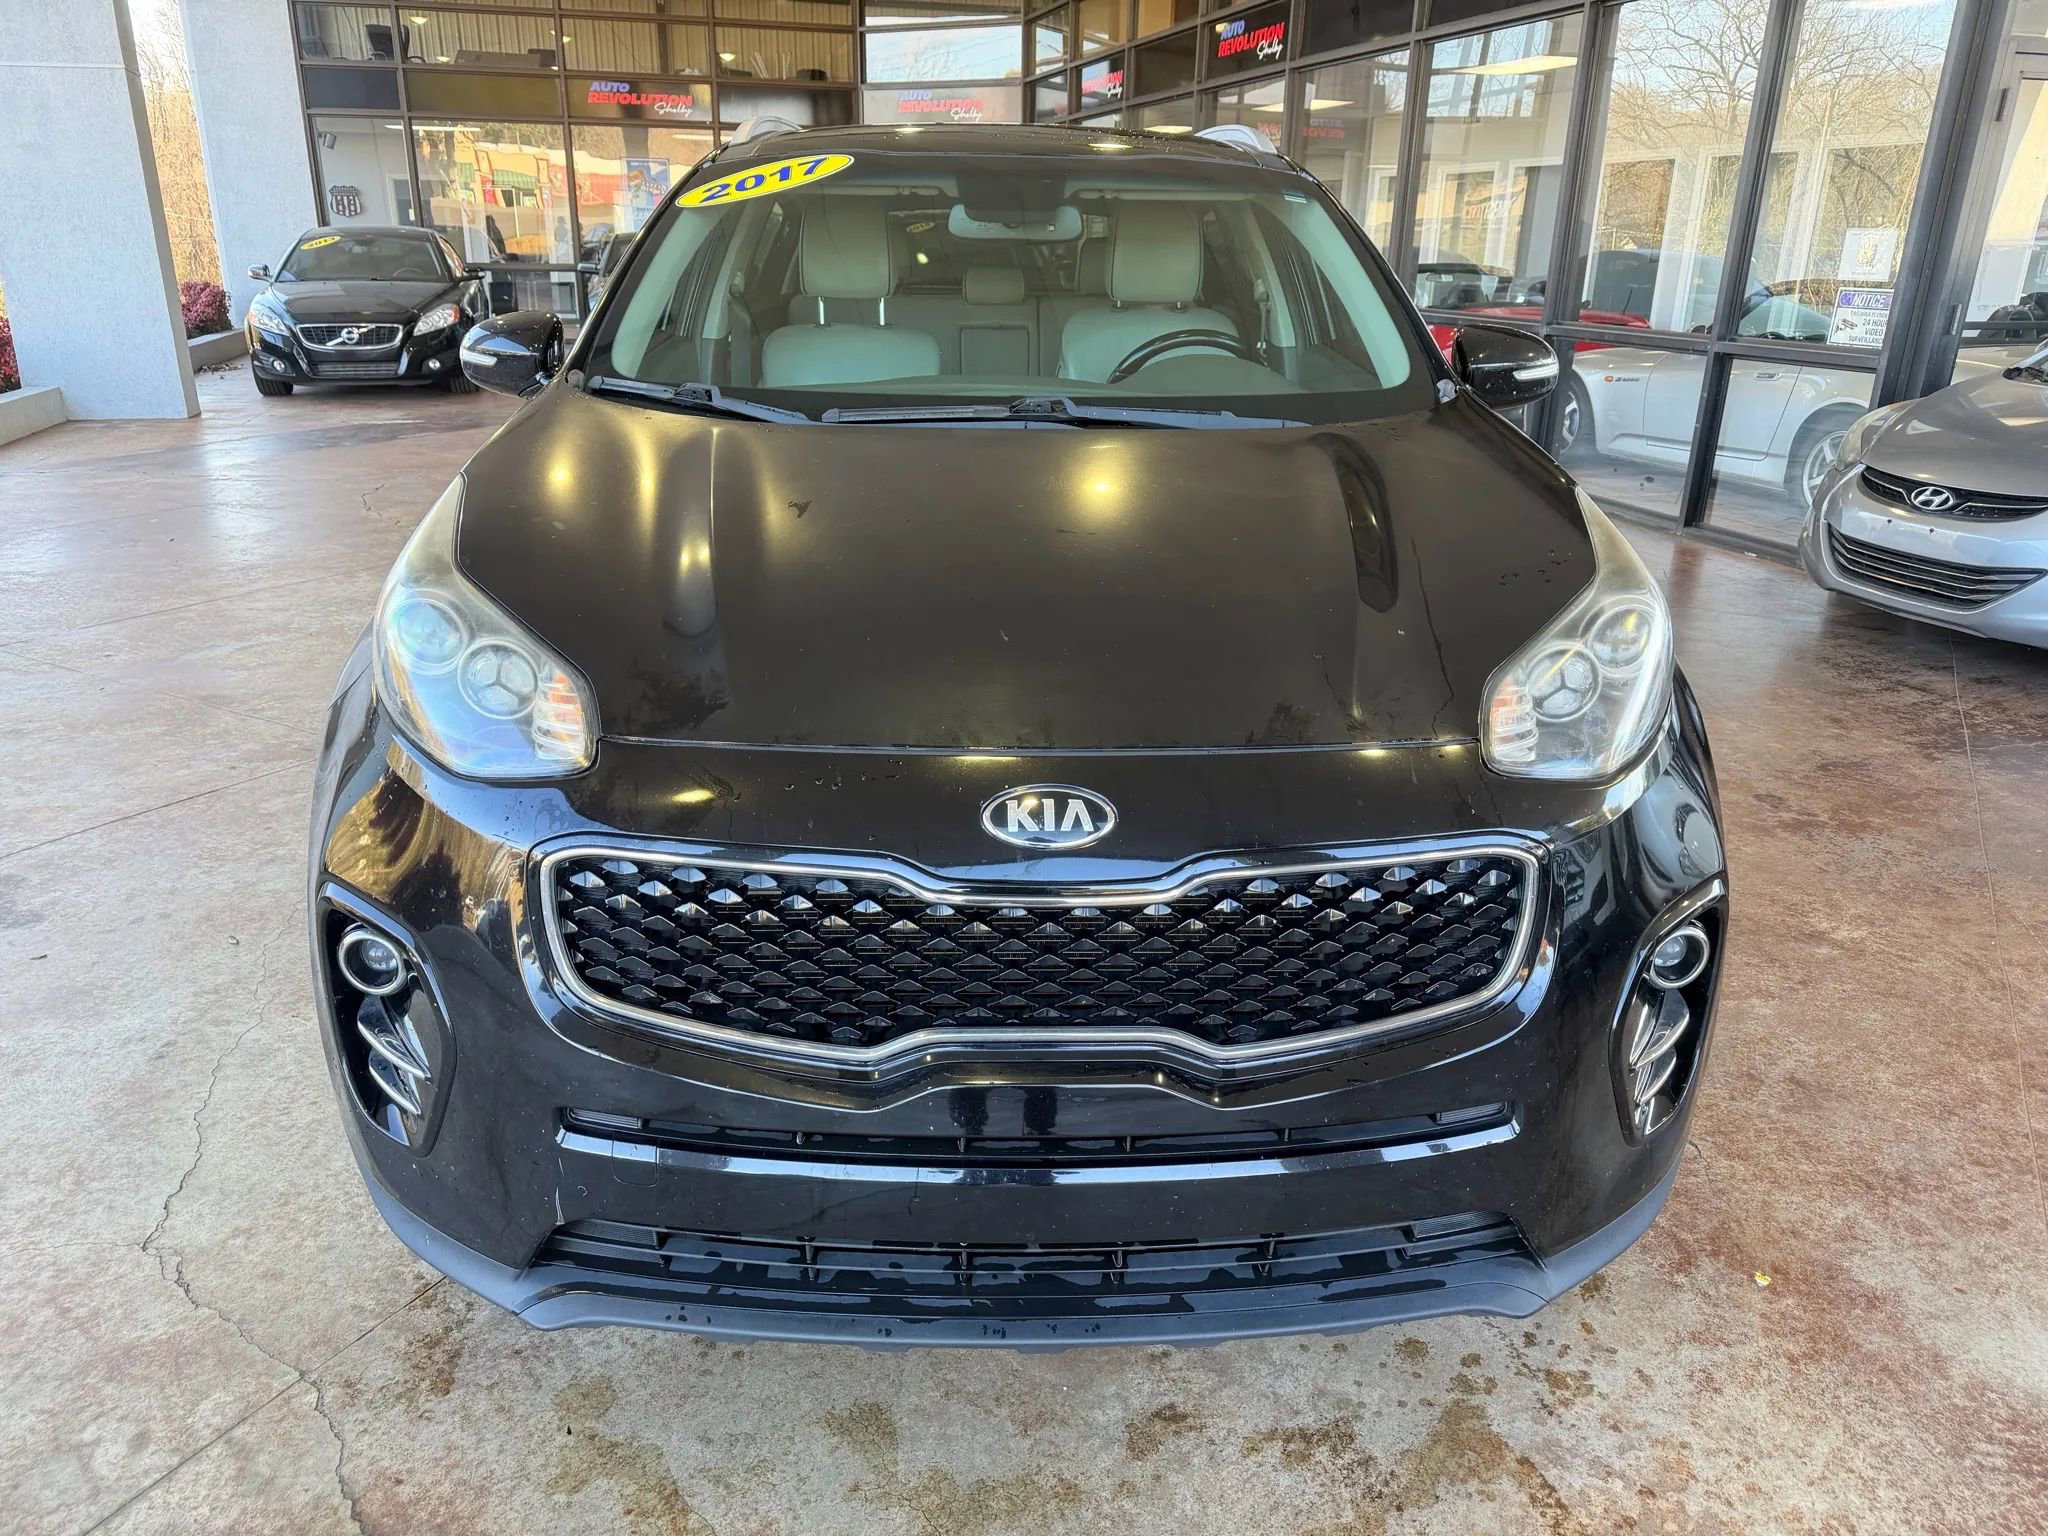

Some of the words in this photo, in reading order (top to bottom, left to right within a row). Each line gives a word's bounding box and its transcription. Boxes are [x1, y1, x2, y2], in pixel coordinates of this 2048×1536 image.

[1220, 20, 1245, 40] AUTO
[1217, 22, 1285, 58] REVOLUTION
[589, 81, 630, 93] AUTO
[587, 92, 693, 106] REVOLUTION
[900, 89, 932, 100] AUTO
[897, 99, 984, 112] REVOLUTION
[699, 156, 829, 203] 2017
[1851, 293, 1886, 307] NOTICE
[1862, 318, 1871, 326] 24
[1865, 328, 1884, 337] VIDEO
[1848, 335, 1882, 344] SURVEILLANC
[1006, 798, 1095, 833] KIA
